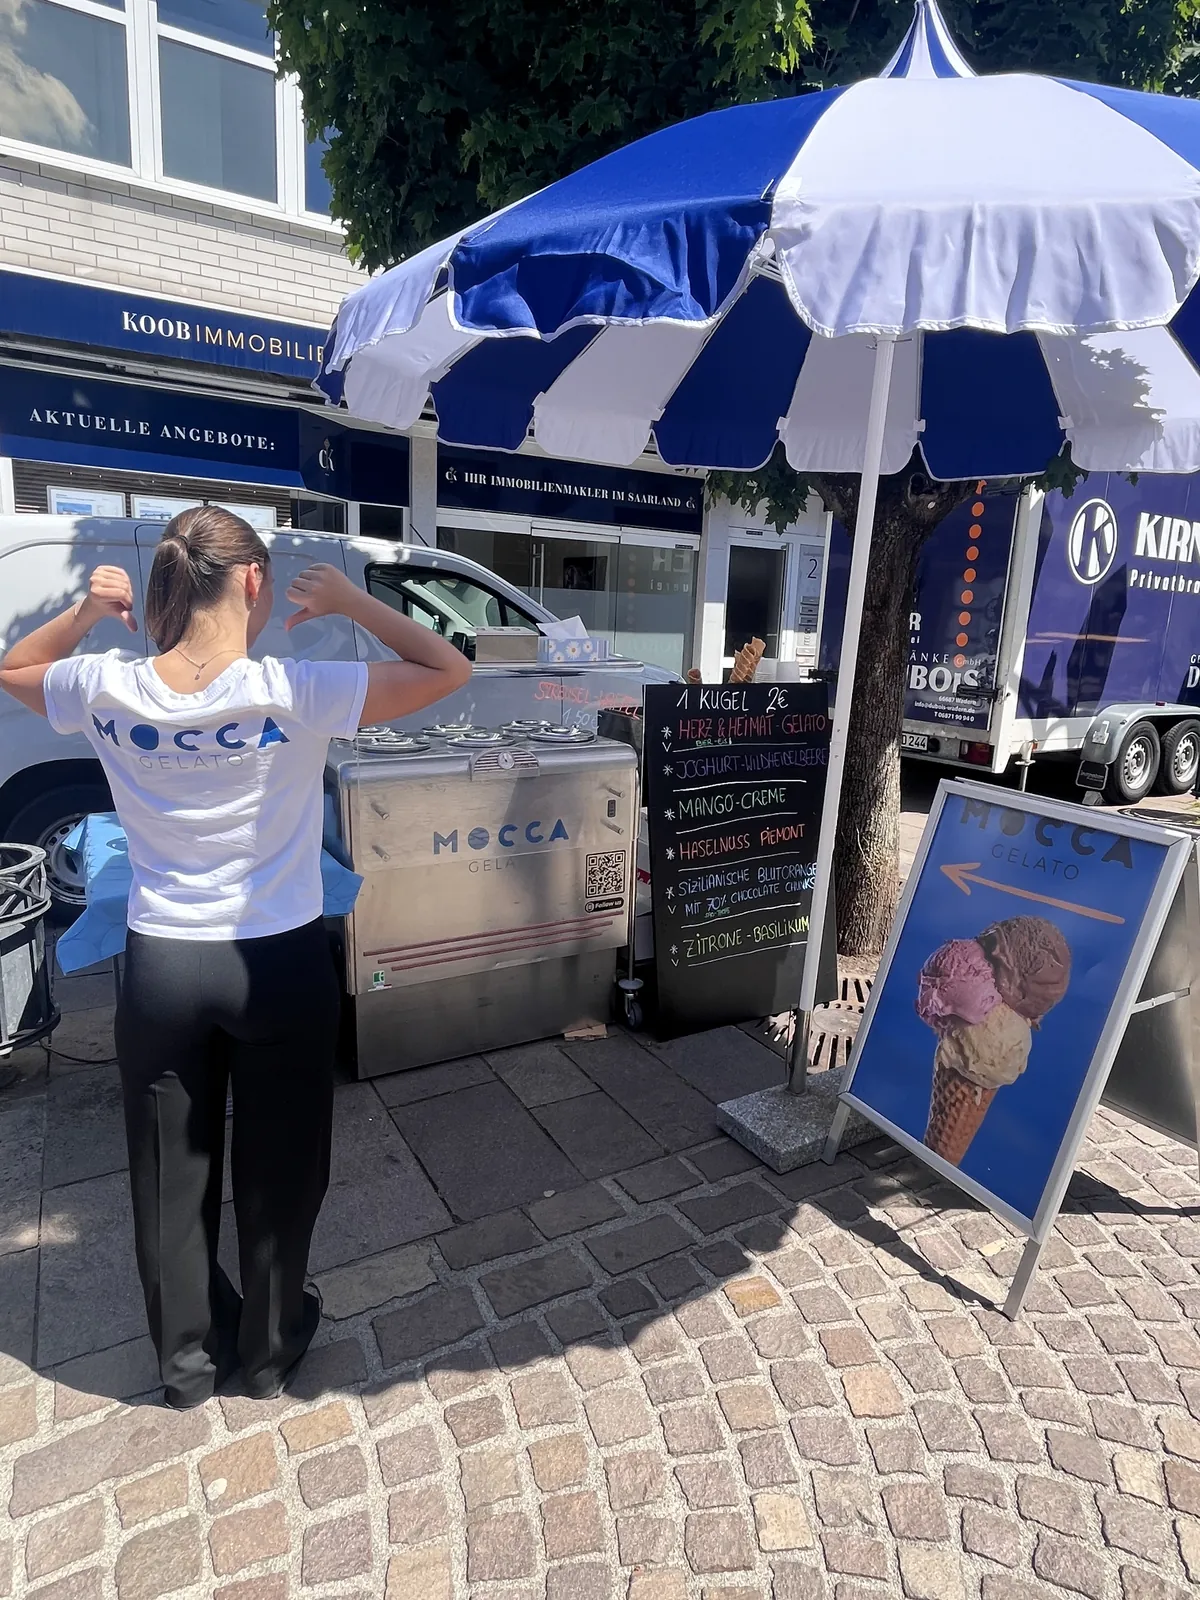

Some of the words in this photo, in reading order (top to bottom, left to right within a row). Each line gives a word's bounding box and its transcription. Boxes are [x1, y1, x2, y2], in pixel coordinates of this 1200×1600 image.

[30, 408, 151, 437] AKTUELLE
[160, 424, 276, 451] ANGEBOTE:
[464, 472, 487, 485] IHR
[491, 475, 609, 500] IMMOBILIENMAKLER
[612, 490, 625, 501] IM
[627, 492, 681, 508] SAARLAND
[807, 558, 819, 580] 2
[676, 688, 688, 710] 1
[699, 688, 750, 712] KUGEL
[765, 687, 789, 714] 2€
[91, 713, 291, 752] MOCCA
[679, 718, 713, 740] HERZ
[717, 717, 726, 738] &
[908, 735, 926, 749] 244
[139, 753, 244, 770] GELATO
[433, 818, 570, 855] MOCCA
[679, 833, 751, 860] HASELNUSS
[960, 797, 1133, 870] MOCCA
[991, 843, 1080, 881] GELATO
[595, 901, 614, 909] Follow
[706, 894, 727, 911] 70%
[730, 882, 780, 904] CHOCOLATE
